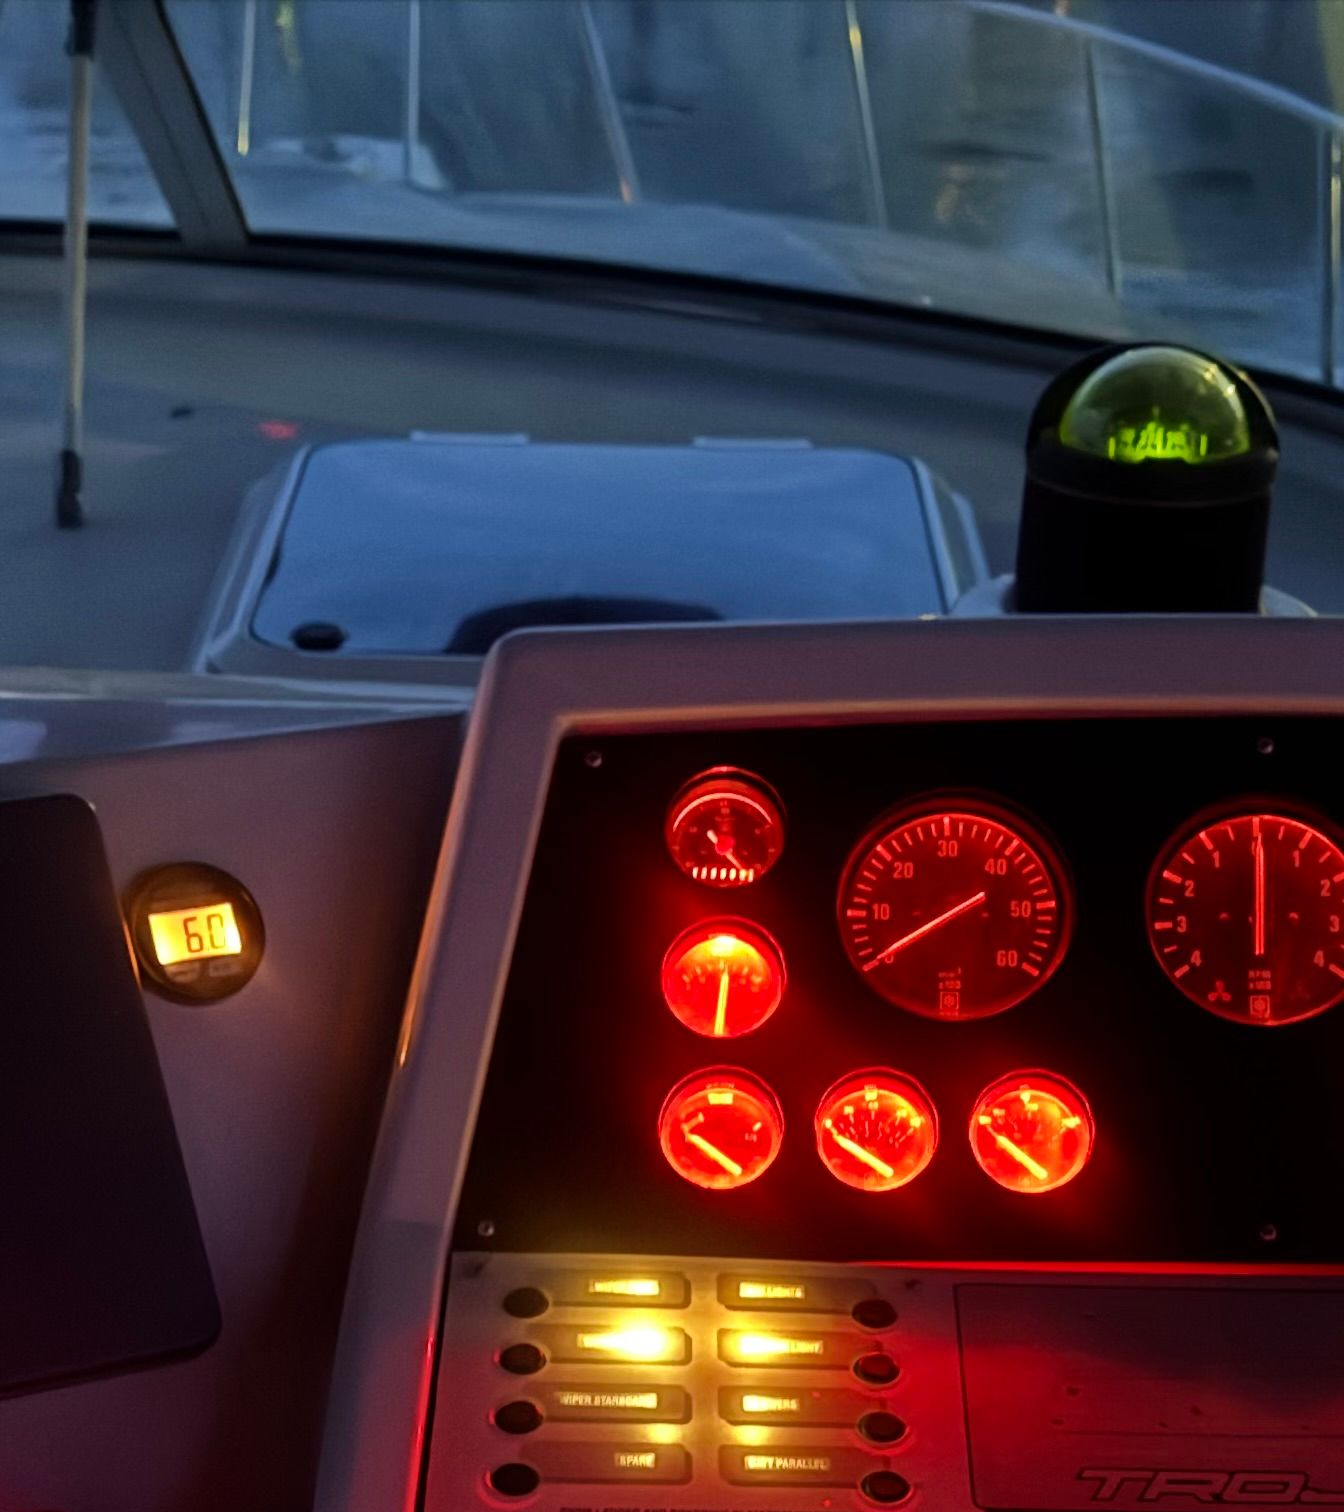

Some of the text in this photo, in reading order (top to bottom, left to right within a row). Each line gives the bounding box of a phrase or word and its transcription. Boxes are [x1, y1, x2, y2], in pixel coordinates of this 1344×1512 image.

[937, 840, 959, 857] 30
[984, 858, 1007, 876] 40
[1212, 850, 1221, 869] 1
[1292, 850, 1301, 868] 1
[892, 862, 915, 879] 20
[1184, 880, 1195, 897] 2
[1320, 879, 1331, 897] 2
[872, 903, 891, 921] 10
[1010, 901, 1032, 918] 50
[1176, 916, 1187, 933] 3
[1329, 915, 1340, 932] 3
[182, 913, 226, 953] 60
[996, 950, 1018, 967] 60
[1190, 949, 1202, 967] 4
[1313, 950, 1325, 968] 4
